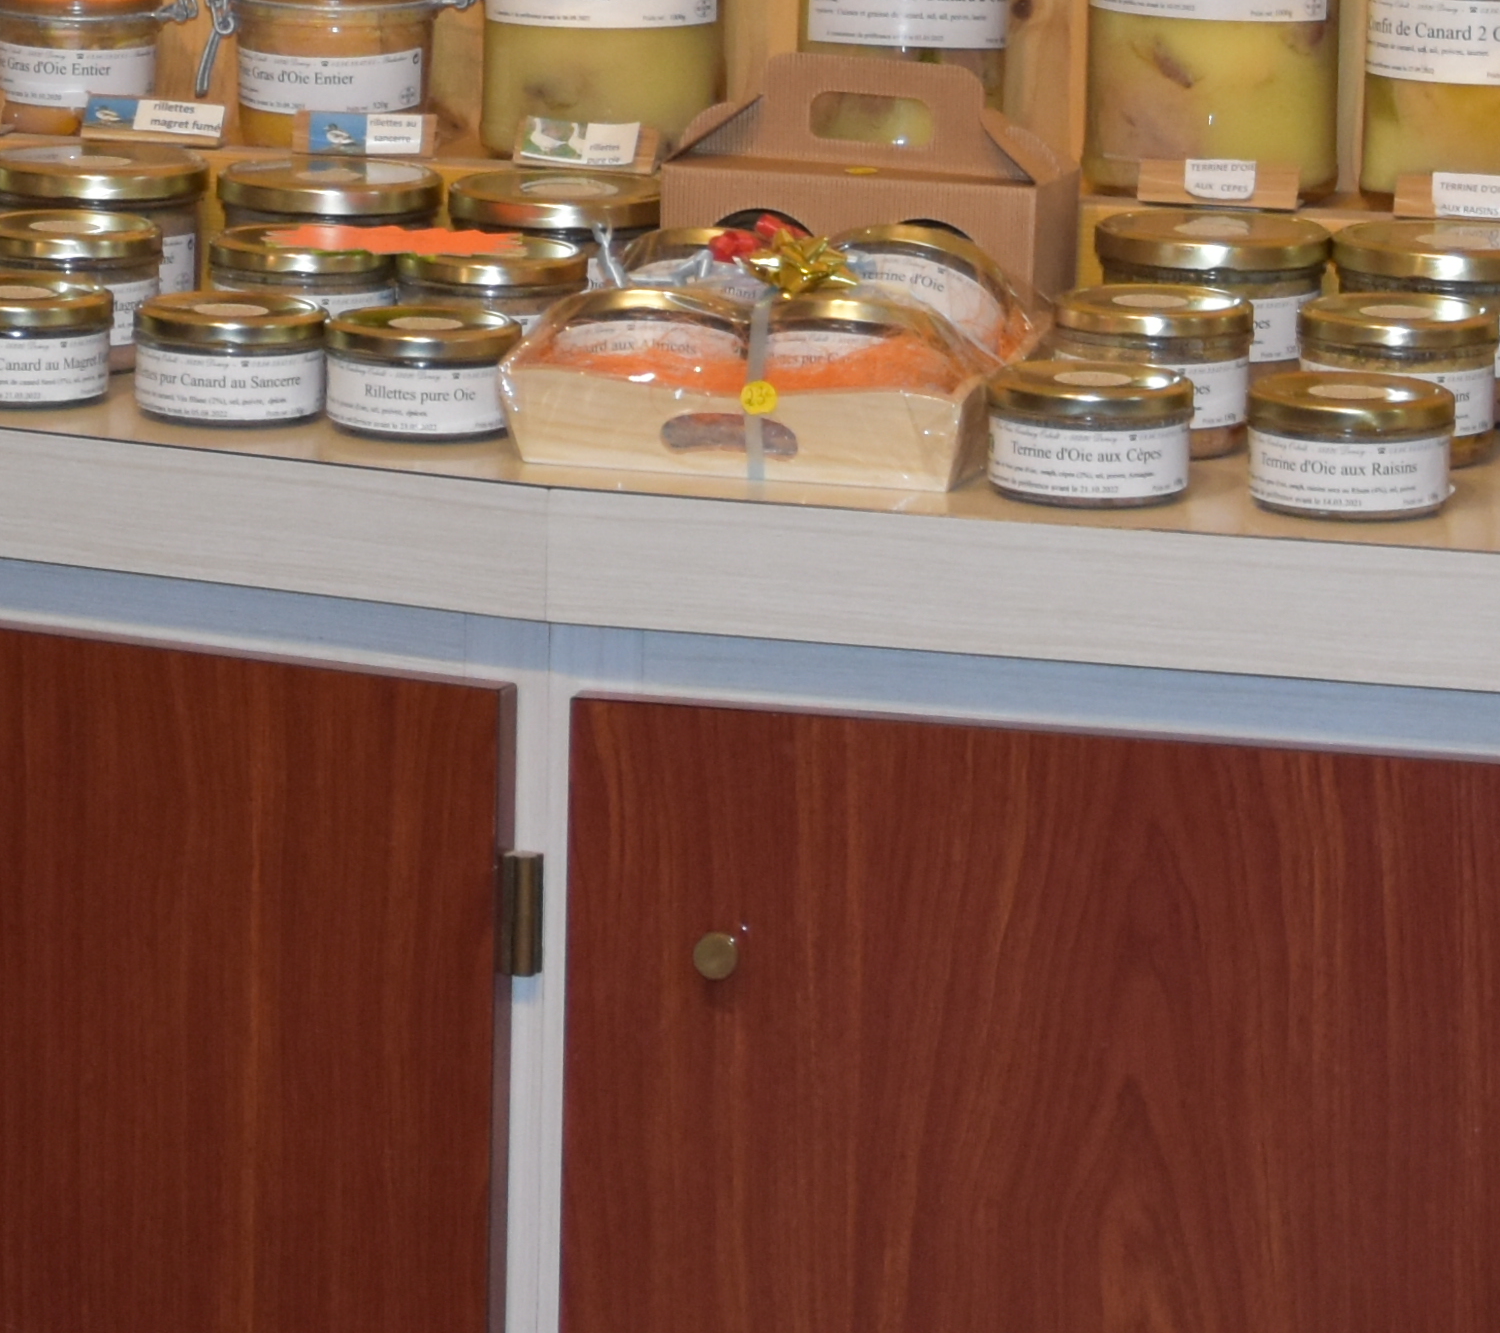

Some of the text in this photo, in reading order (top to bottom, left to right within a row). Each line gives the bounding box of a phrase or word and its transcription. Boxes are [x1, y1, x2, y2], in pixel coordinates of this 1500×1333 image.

[1395, 20, 1410, 36] de
[1414, 22, 1471, 40] Canard
[1477, 25, 1486, 41] 2
[153, 101, 195, 114] rillettes
[151, 118, 189, 130] magret
[365, 383, 476, 406] Rillettes pure Oie
